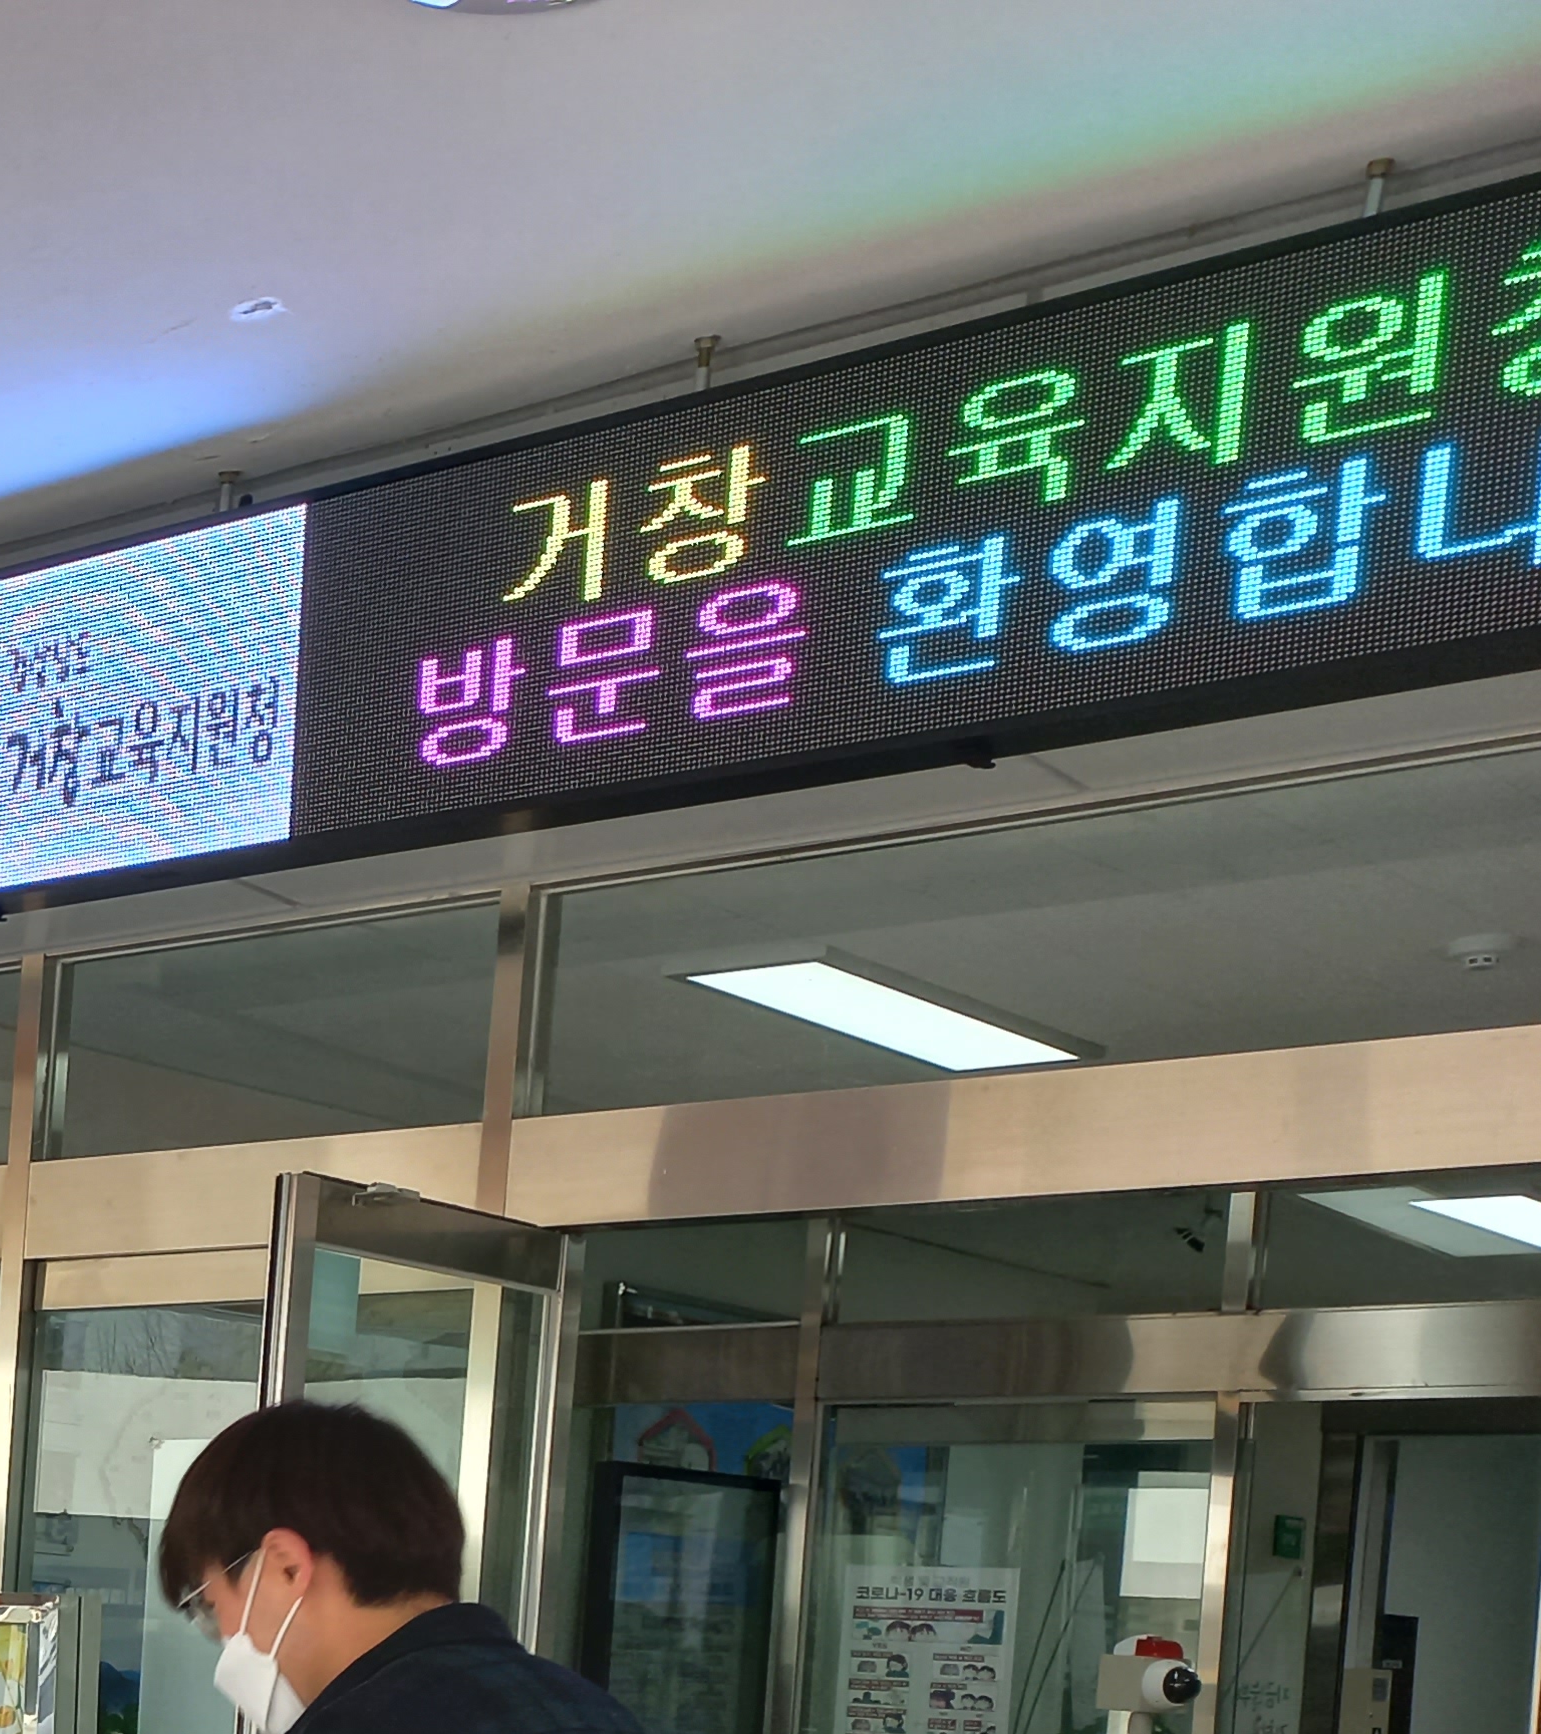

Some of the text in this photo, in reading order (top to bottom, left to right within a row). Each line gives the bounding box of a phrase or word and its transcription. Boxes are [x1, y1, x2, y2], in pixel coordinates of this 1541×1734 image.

[417, 579, 810, 767] 방문을
[4, 675, 280, 808] 거창교육지원청
[855, 1585, 924, 1601] 코로나-19
